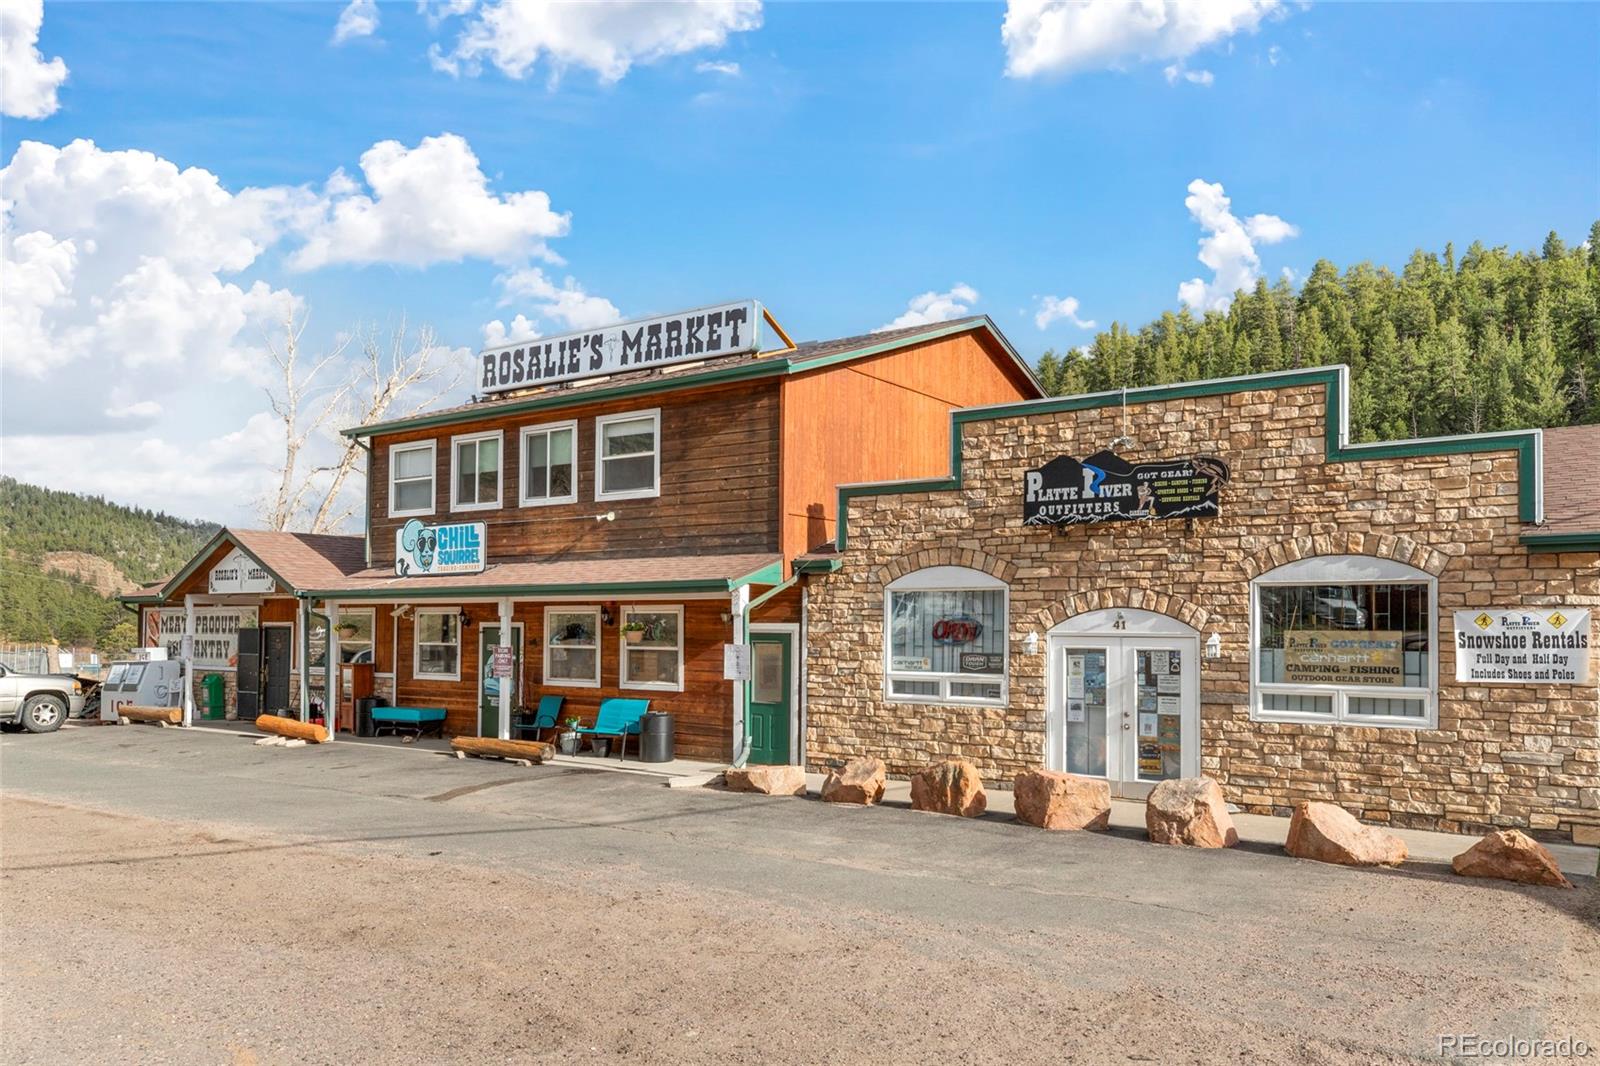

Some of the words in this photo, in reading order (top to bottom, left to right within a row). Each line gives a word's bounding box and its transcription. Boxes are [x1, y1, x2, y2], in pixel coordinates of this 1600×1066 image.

[482, 333, 603, 387] ROSALIE'S
[620, 307, 747, 365] MARKET
[1027, 472, 1078, 502] PLATTE
[1082, 468, 1132, 500] RIVER
[1040, 502, 1120, 516] OUTFITTERS
[438, 549, 480, 565] SQUIRREL
[161, 616, 187, 634] MEAT
[196, 616, 240, 634] PRODUCE
[1112, 620, 1126, 630] 41
[1458, 632, 1526, 648] Snowshoe
[1532, 631, 1588, 648] Rentals
[194, 640, 230, 659] ANTRY
[1476, 654, 1492, 664] Full
[1495, 654, 1510, 666] Day
[1513, 654, 1527, 664] and
[1532, 654, 1550, 664] Half
[1553, 654, 1568, 666] Day
[1286, 664, 1340, 673] CAMPING
[1350, 666, 1400, 674] FISHING
[1471, 669, 1505, 679] Includes
[1508, 669, 1531, 679] Shoes
[1535, 669, 1550, 679] and
[1553, 669, 1575, 680] Poles
